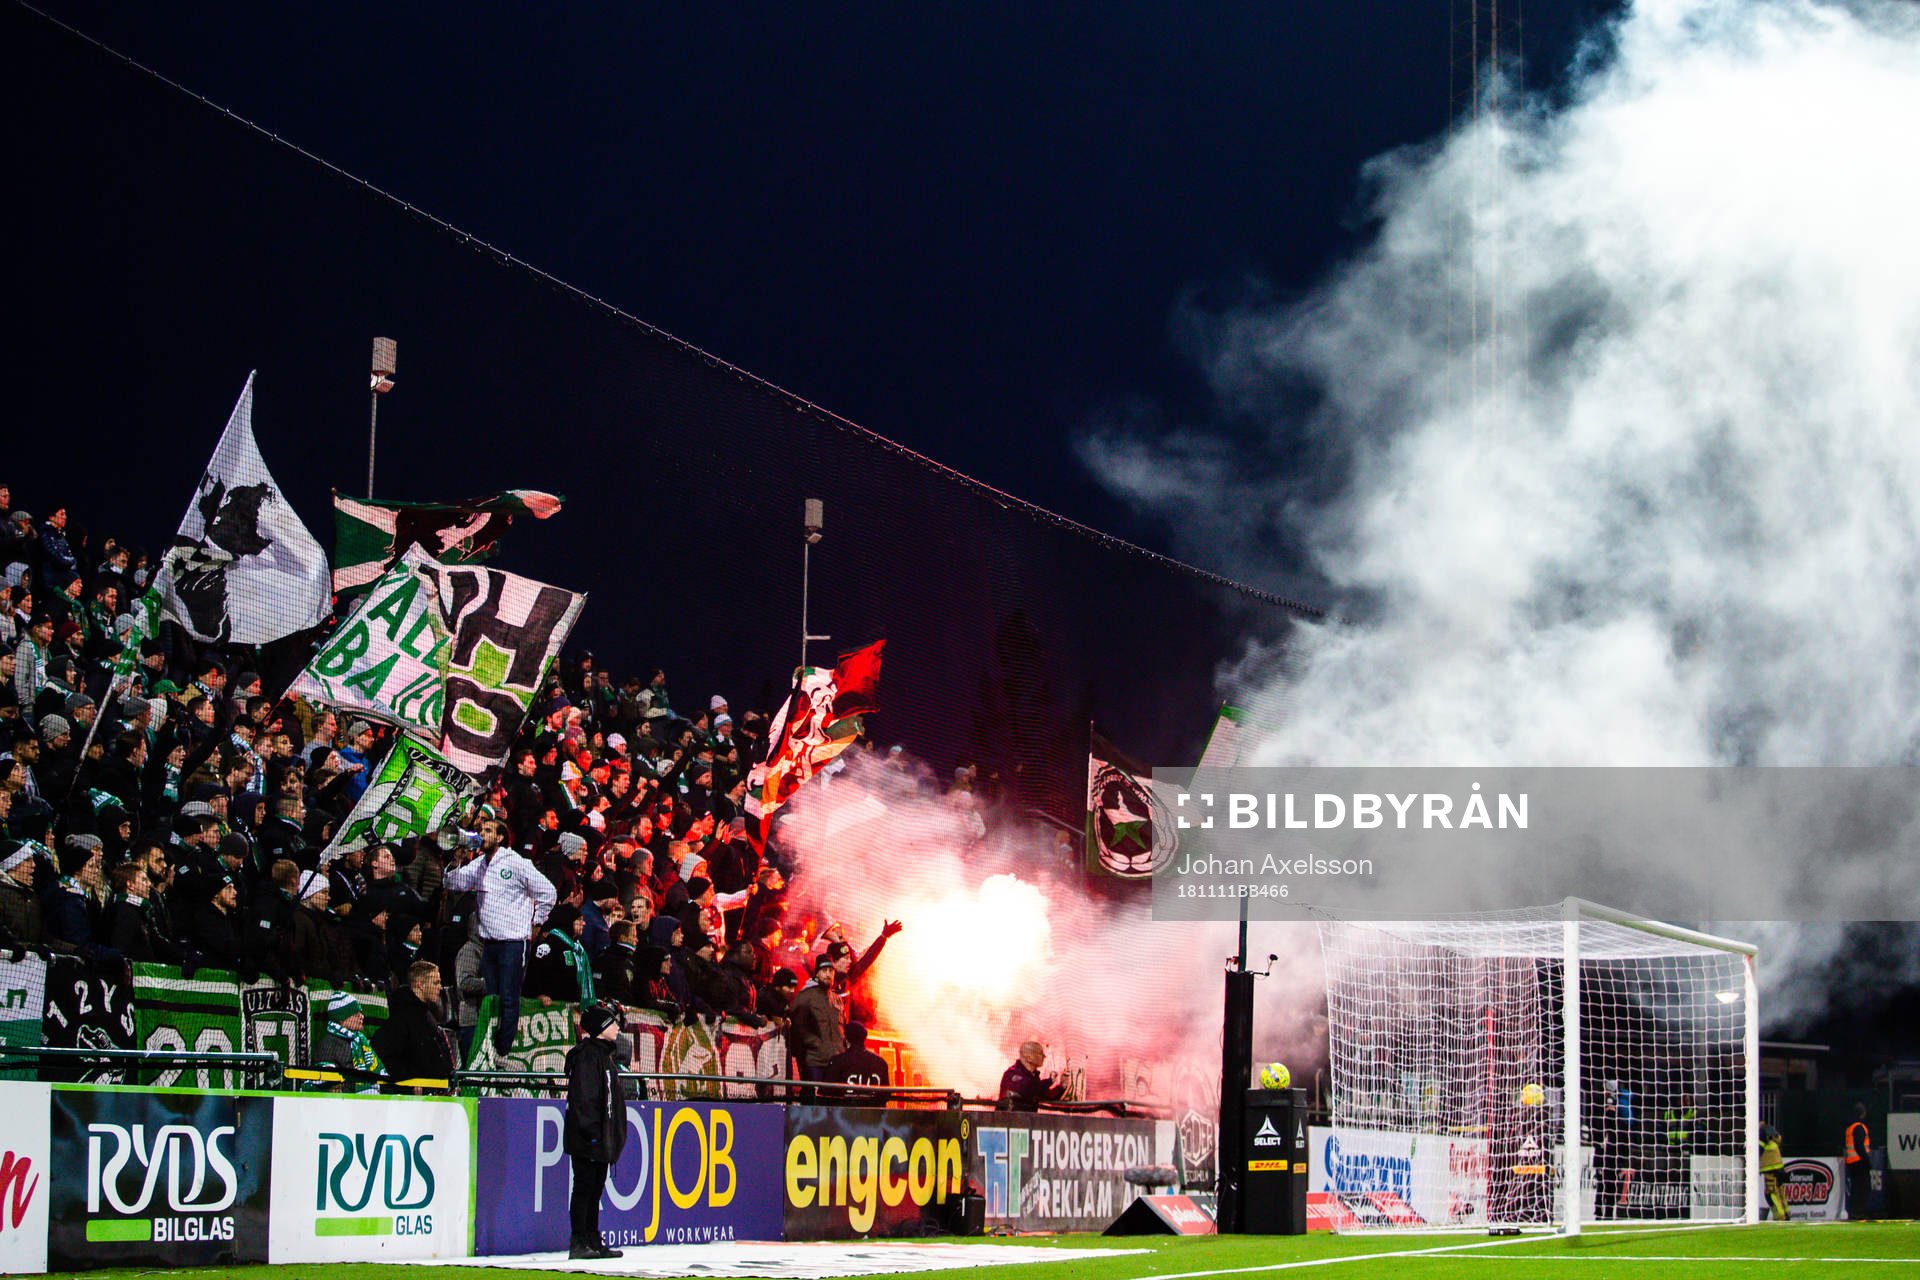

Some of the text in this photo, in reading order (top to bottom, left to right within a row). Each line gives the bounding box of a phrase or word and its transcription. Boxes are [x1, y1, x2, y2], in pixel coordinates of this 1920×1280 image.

[409, 749, 468, 791] ULTRAS
[1032, 1130, 1149, 1171] THORGERZON
[1254, 1136, 1281, 1146] SELECT
[534, 1105, 737, 1242] POJOB
[1039, 1179, 1112, 1218] REKLAM
[154, 1216, 234, 1242] BILGLAS
[396, 1214, 433, 1236] GLAS
[666, 1225, 735, 1242] WORKWEAR
